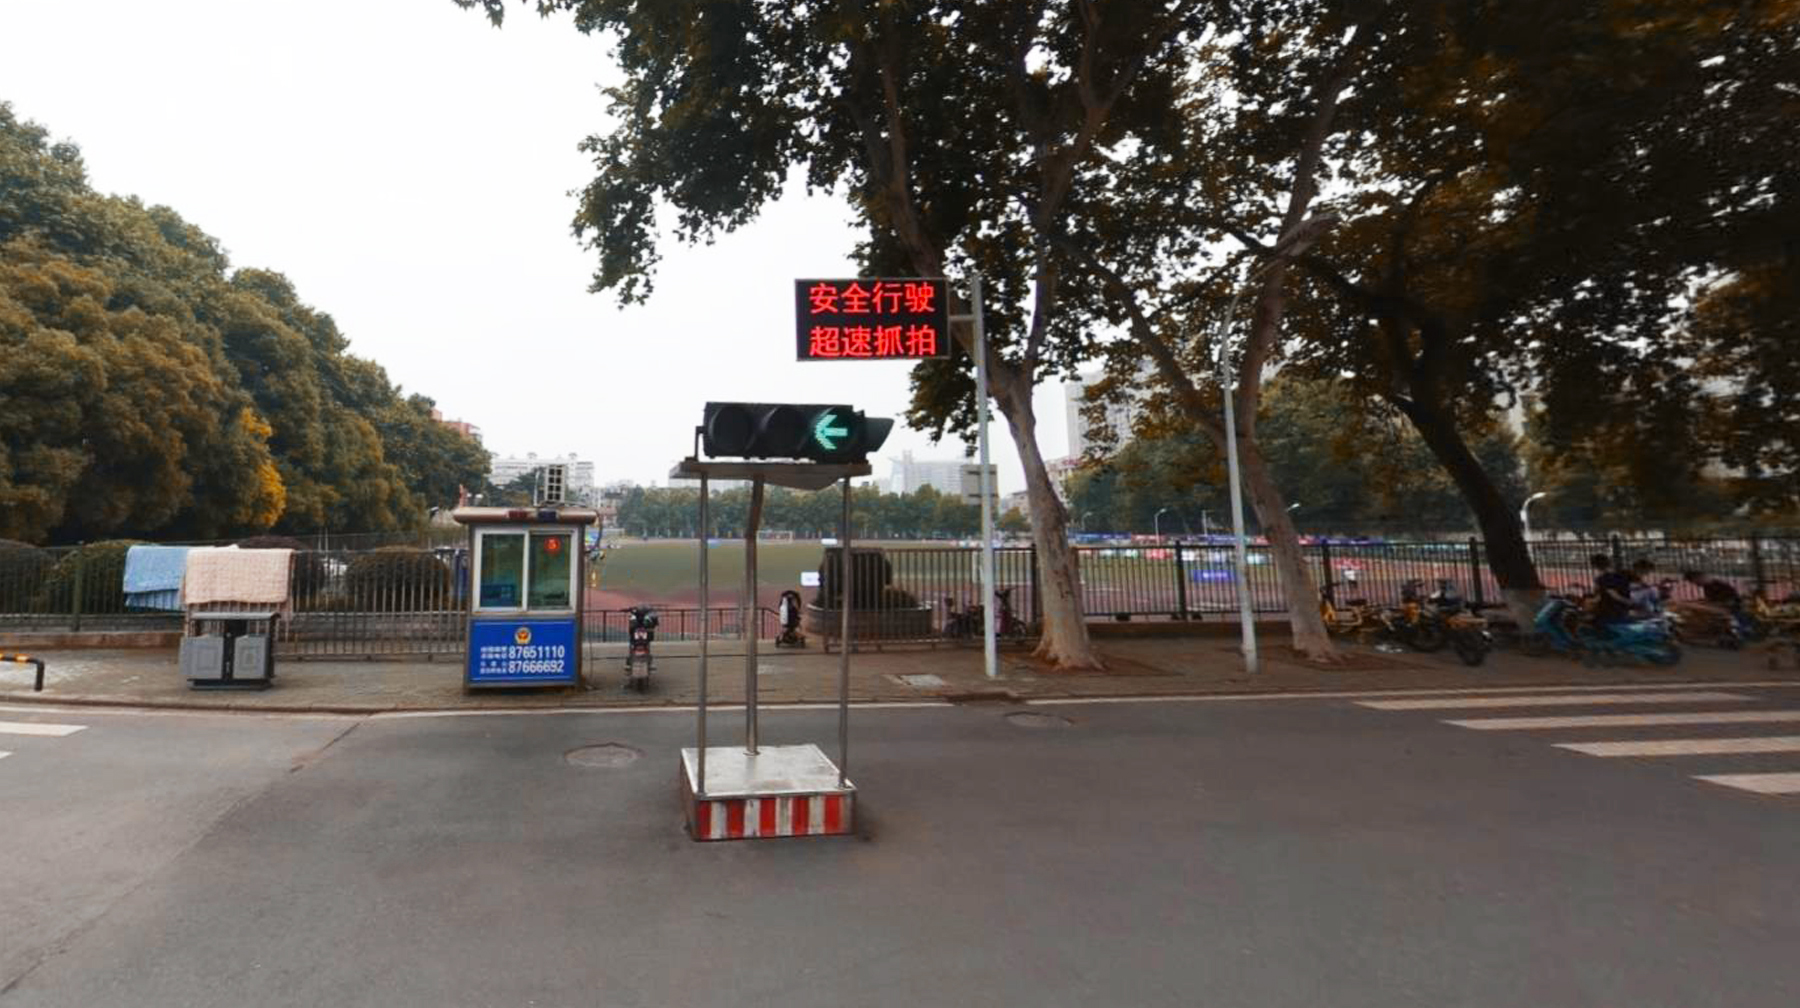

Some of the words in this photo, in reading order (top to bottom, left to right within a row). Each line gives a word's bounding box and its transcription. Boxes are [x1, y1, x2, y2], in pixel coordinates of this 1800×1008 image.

[809, 282, 935, 314] 安全行驶
[809, 325, 936, 357] 超速抓拍
[508, 645, 565, 659] 87651110
